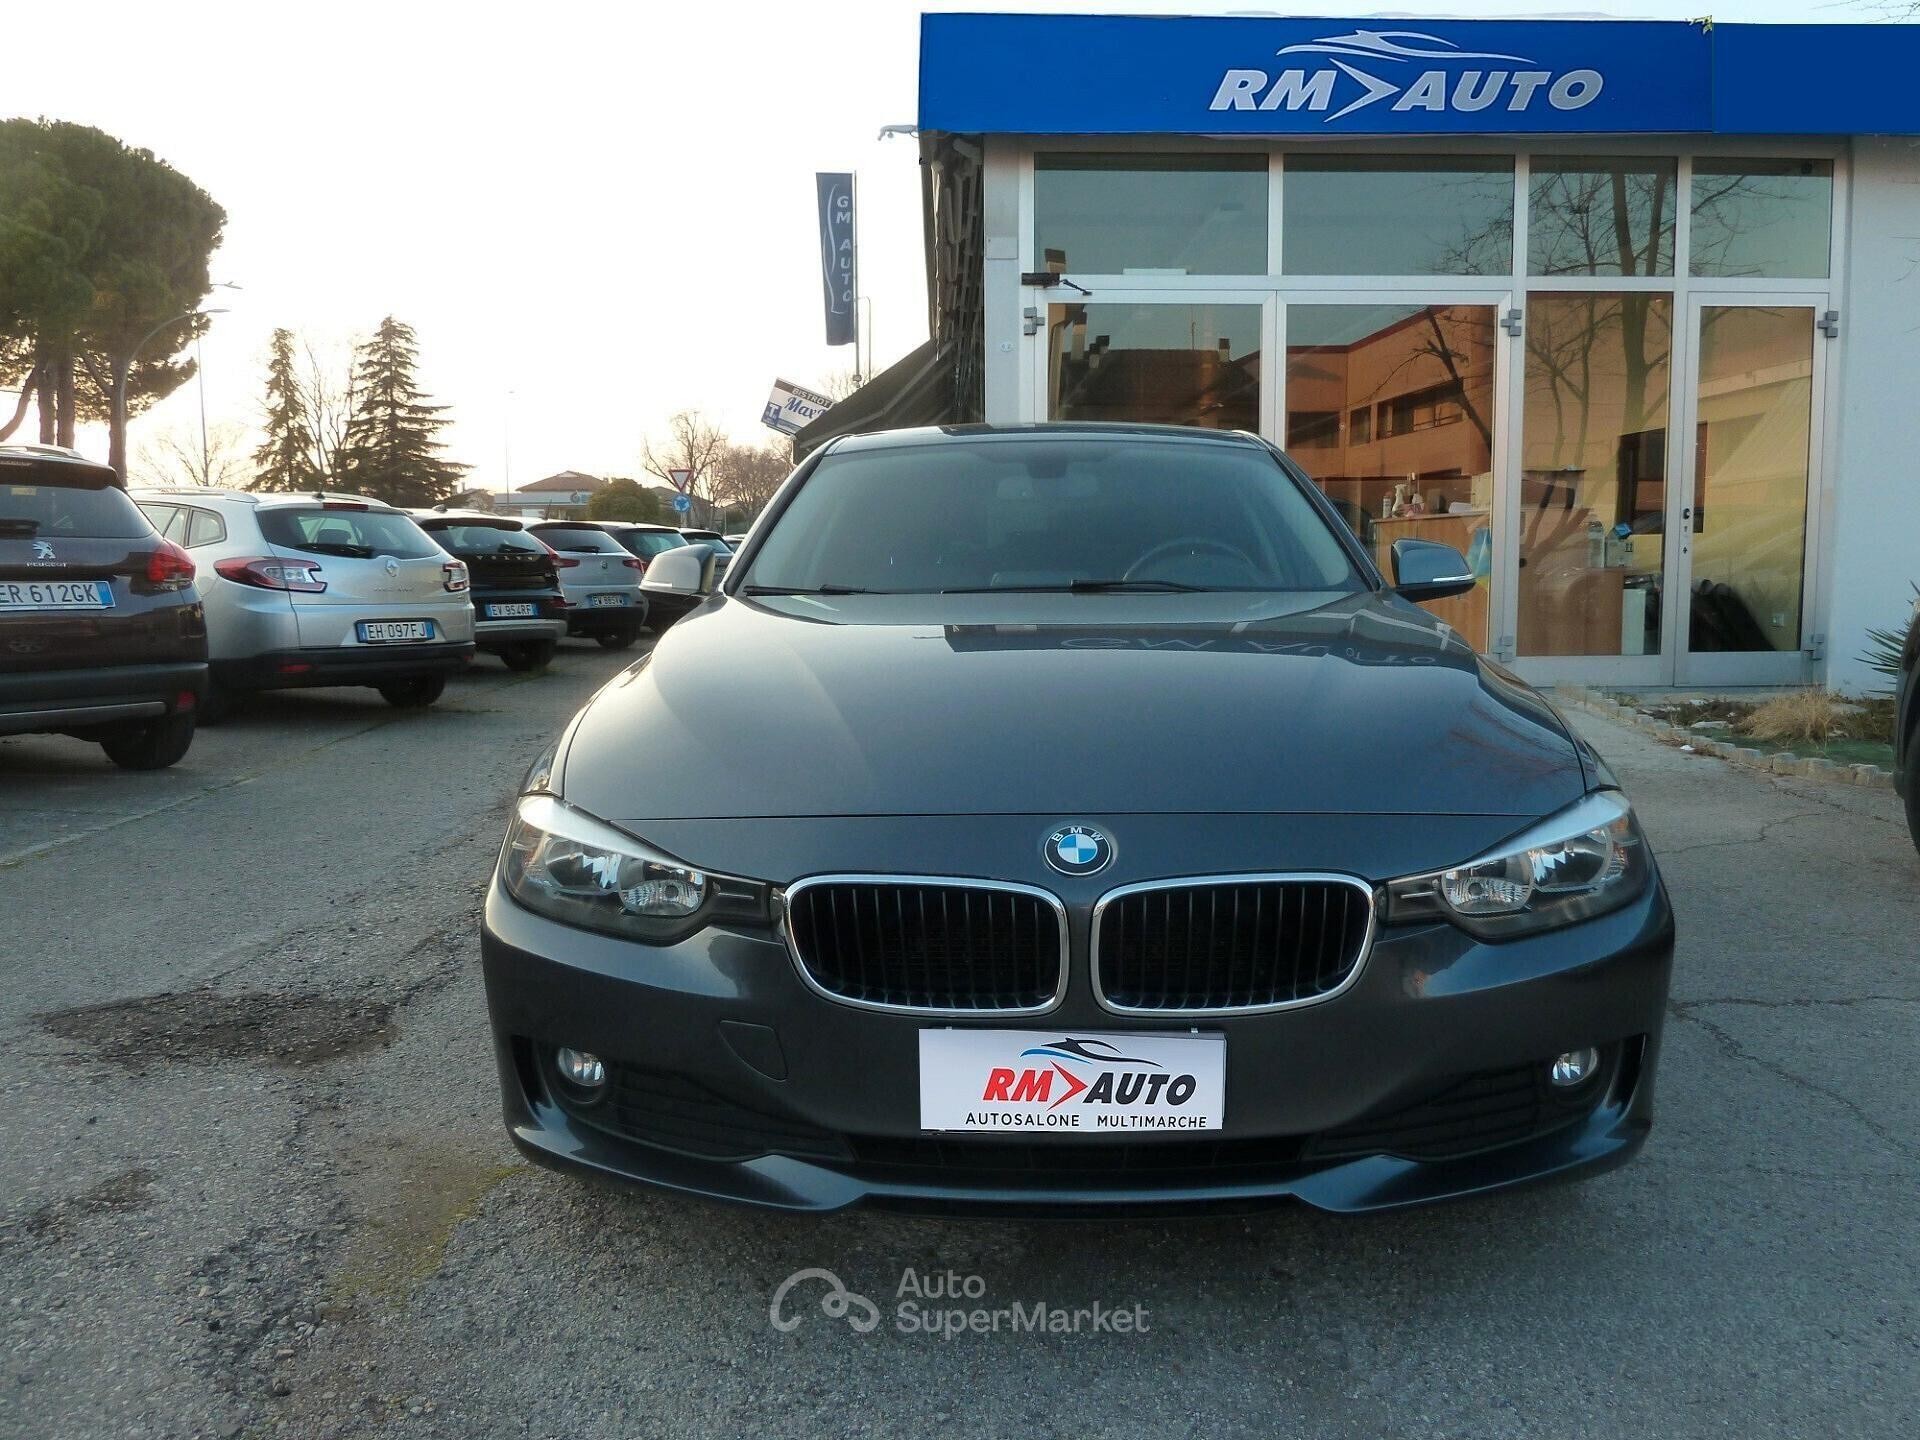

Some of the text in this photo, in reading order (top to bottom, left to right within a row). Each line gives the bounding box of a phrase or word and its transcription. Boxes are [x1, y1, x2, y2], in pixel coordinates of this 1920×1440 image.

[1391, 69, 1604, 112] AUTO
[836, 195, 851, 302] GM AUTO
[792, 387, 830, 408] BISTROT
[0, 584, 98, 603] ER 612GK
[491, 604, 532, 616] EV 954RF
[367, 622, 426, 639] EH 097FJ
[1051, 826, 1104, 842] BMW
[982, 1067, 1197, 1105] RM AUTO
[965, 1112, 1207, 1128] AUTOSALONE MULTIMARCHE
